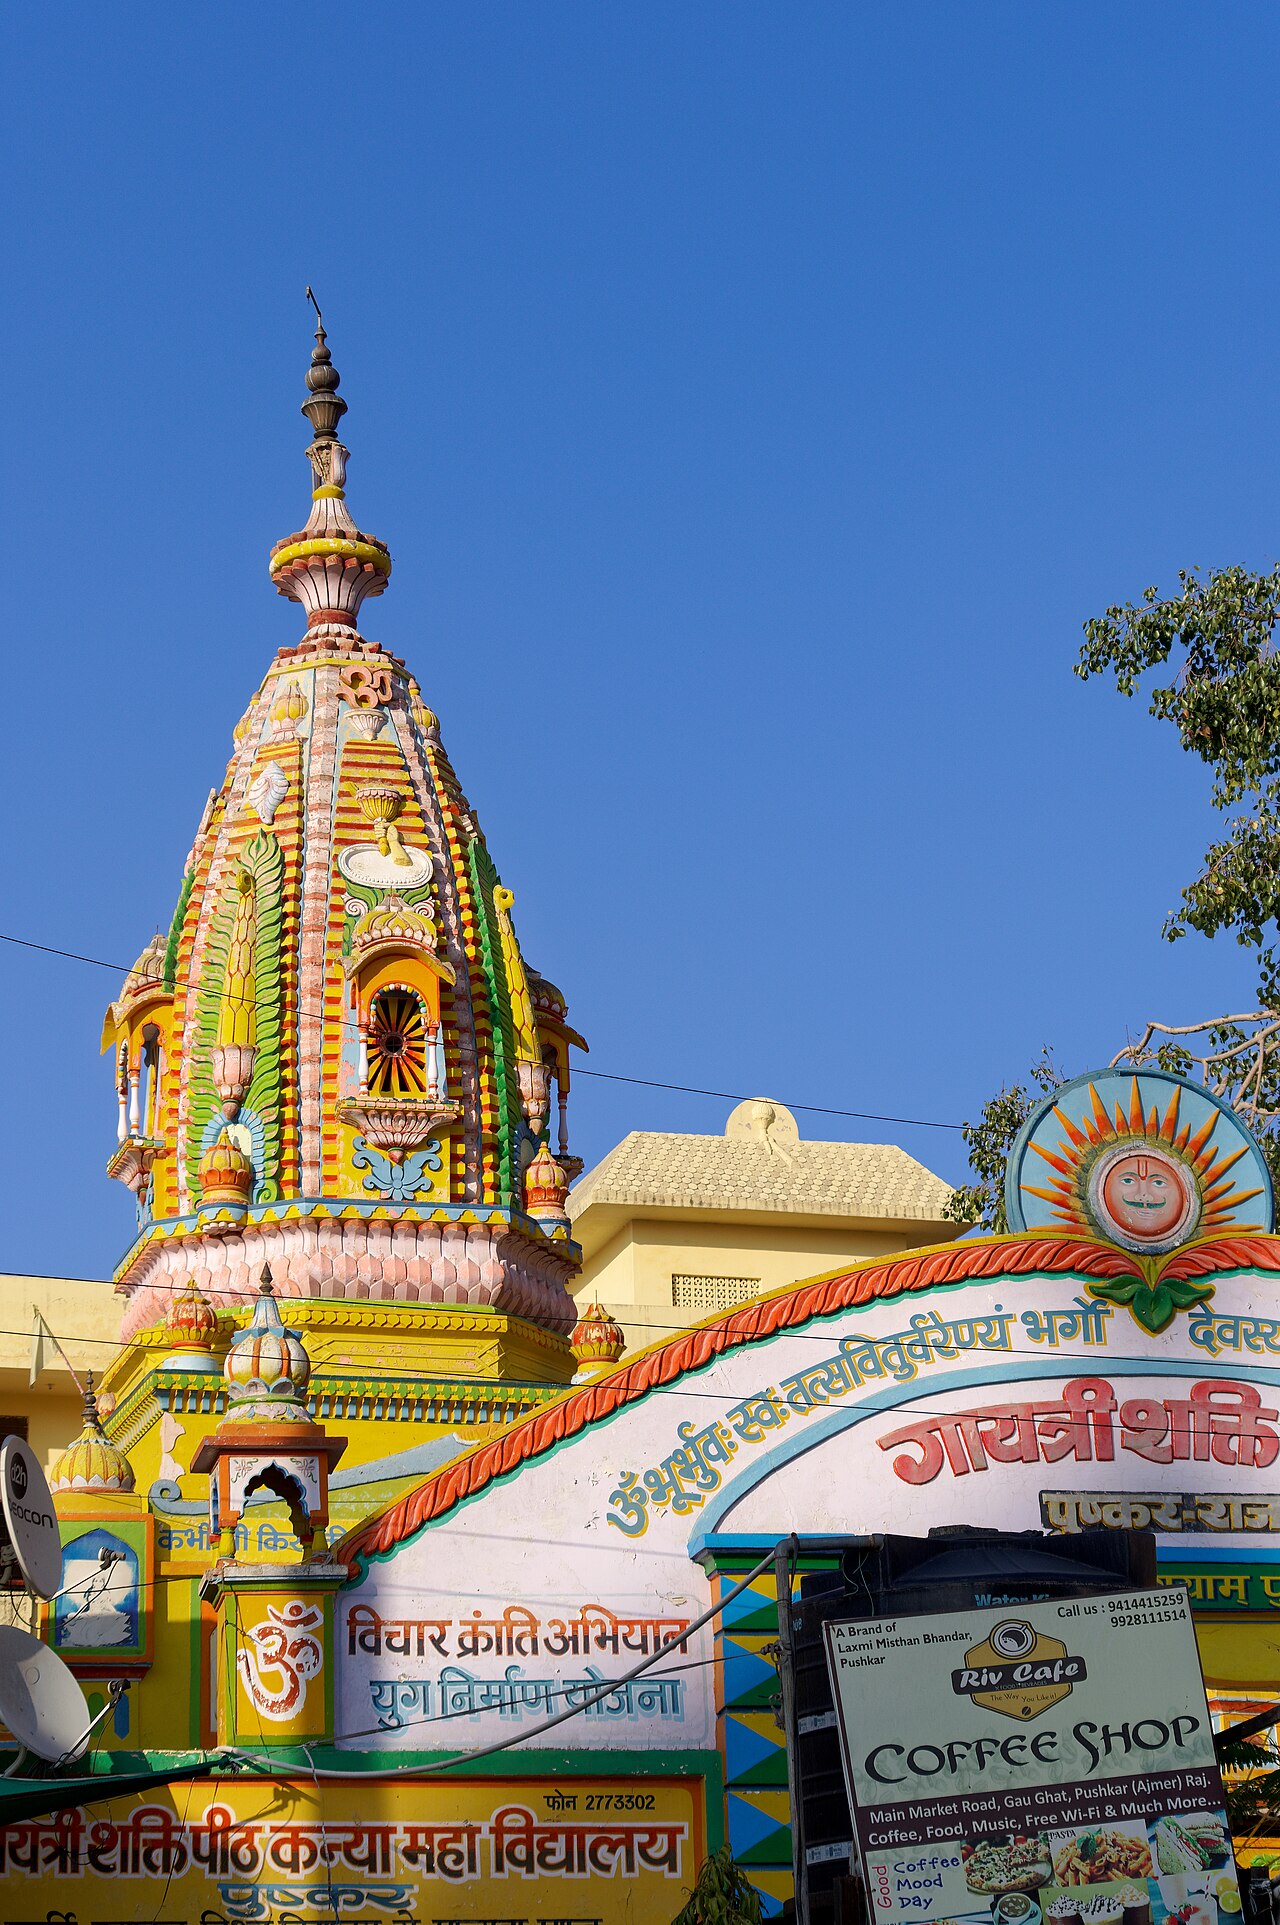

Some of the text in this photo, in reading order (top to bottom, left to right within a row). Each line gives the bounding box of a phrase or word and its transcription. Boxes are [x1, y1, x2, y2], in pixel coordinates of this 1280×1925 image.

[875, 1376, 1118, 1486] गायत्री
[11, 1463, 27, 1487] d2h
[1057, 1606, 1081, 1618] Call
[1083, 1606, 1098, 1615] us
[1108, 1593, 1184, 1612] 9414415259
[1110, 1608, 1187, 1627] 9928111514
[346, 1603, 691, 1659] विचार क्रांति अभियान
[835, 1622, 897, 1638] A Brand of
[838, 1631, 973, 1653] Laxmi Misthan Bhandar,
[840, 1655, 886, 1669] Pushkar
[959, 1660, 1079, 1688] Riv Cafe
[369, 1679, 432, 1734] युग
[437, 1665, 558, 1721] निर्माण
[990, 1694, 1003, 1702] The
[864, 1715, 1201, 1784] COFFEE SHOP
[543, 1789, 655, 1811] फोन 2773302
[869, 1772, 1211, 1824] Main Market Road, Gau Ghat, Pushkar (Ajmer) Raj.
[868, 1795, 1221, 1846] Coffee, Food, Music, Free Wi-Fi & Much More...
[0, 1806, 87, 1875] यत्री
[269, 1825, 397, 1876] कन्या
[401, 1825, 482, 1879] महा
[489, 1806, 685, 1876] विद्यालय
[893, 1856, 961, 1874] Coffee
[872, 1865, 893, 1909] Good
[896, 1873, 943, 1891] Mood
[898, 1895, 933, 1911] Day
